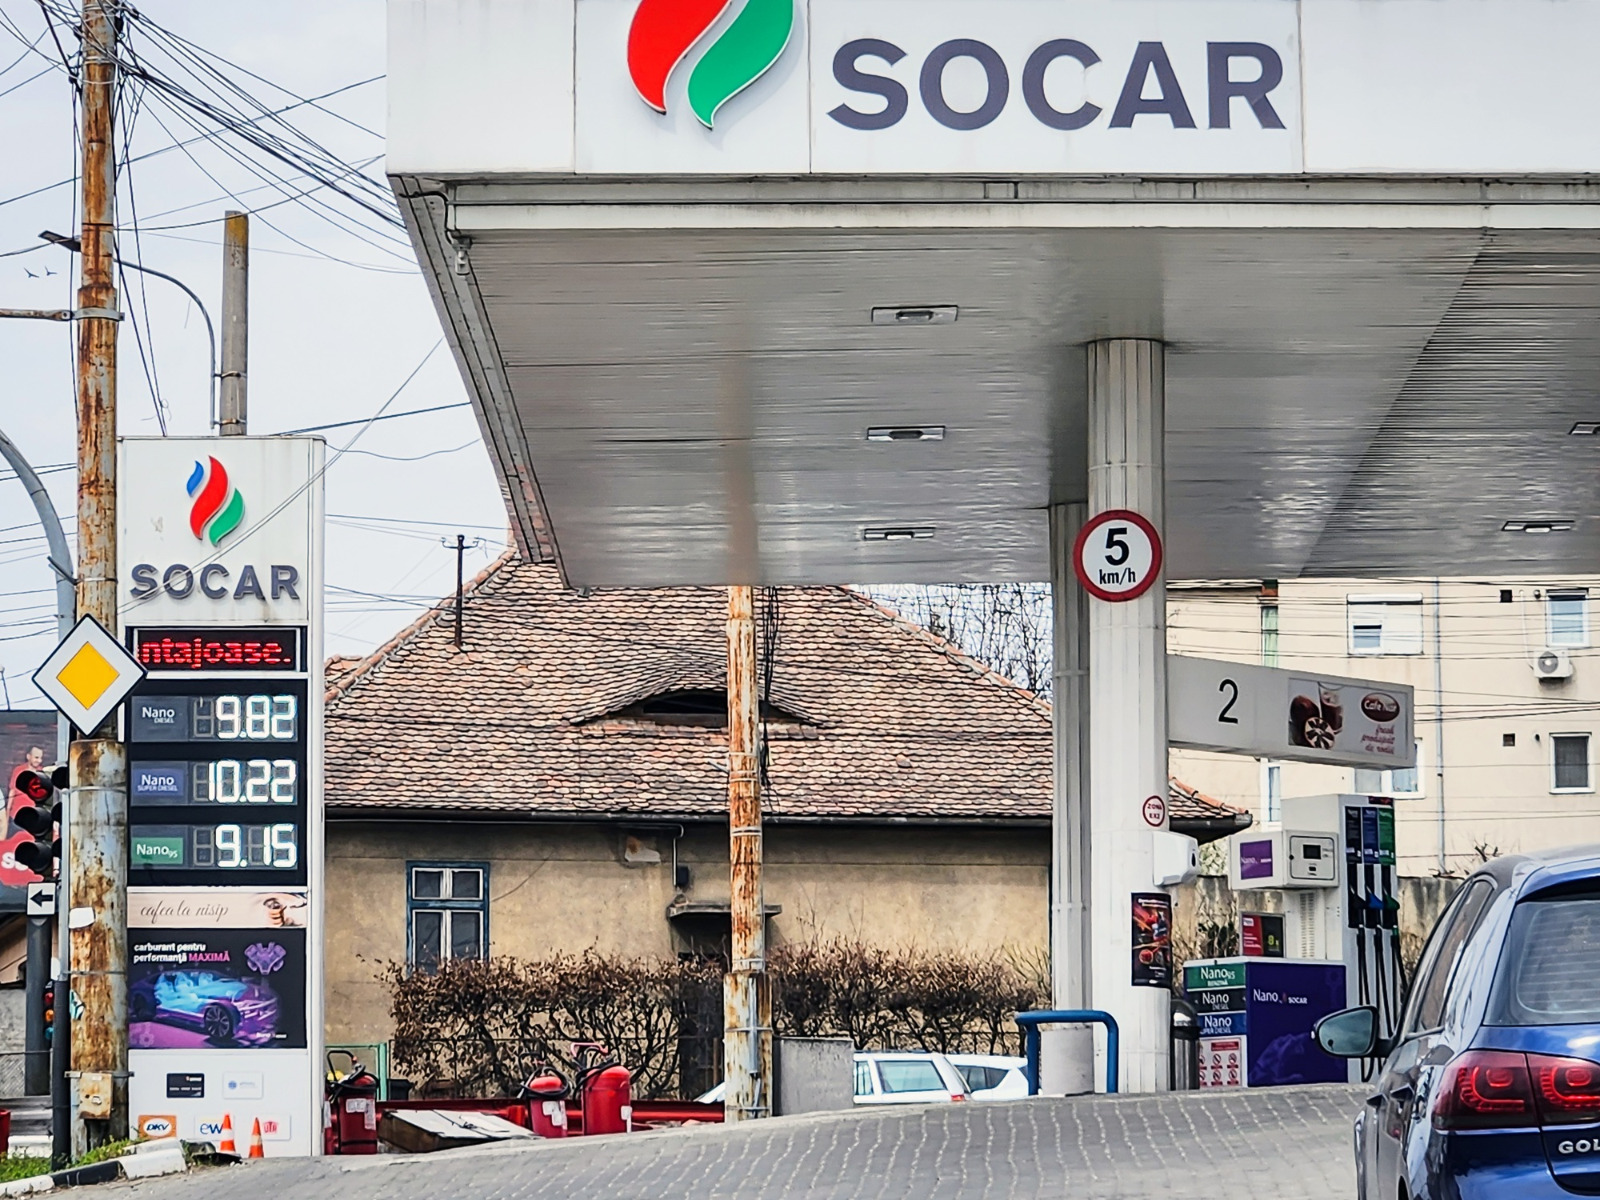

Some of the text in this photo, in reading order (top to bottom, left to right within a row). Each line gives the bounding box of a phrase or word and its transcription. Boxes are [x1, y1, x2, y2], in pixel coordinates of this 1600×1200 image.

[827, 38, 1286, 131] SOCAR
[1105, 527, 1129, 566] 5
[130, 563, 300, 600] SOCAR
[1099, 567, 1136, 585] km/h
[136, 638, 291, 669] ntajoase.
[1218, 678, 1239, 724] 2
[142, 694, 297, 739] Nano 9.82
[141, 759, 297, 803] Nano 10.22
[215, 823, 297, 868] 9.15
[140, 900, 228, 924] cafea la nisip
[133, 942, 206, 954] carburant pentru
[189, 951, 230, 962] MAXIMĂ
[1202, 992, 1229, 1005] Nano
[1253, 988, 1307, 1004] Nano SOCAR
[1204, 1015, 1232, 1029] Nano
[146, 1123, 170, 1131] DKV
[1558, 1138, 1600, 1154] GOL
